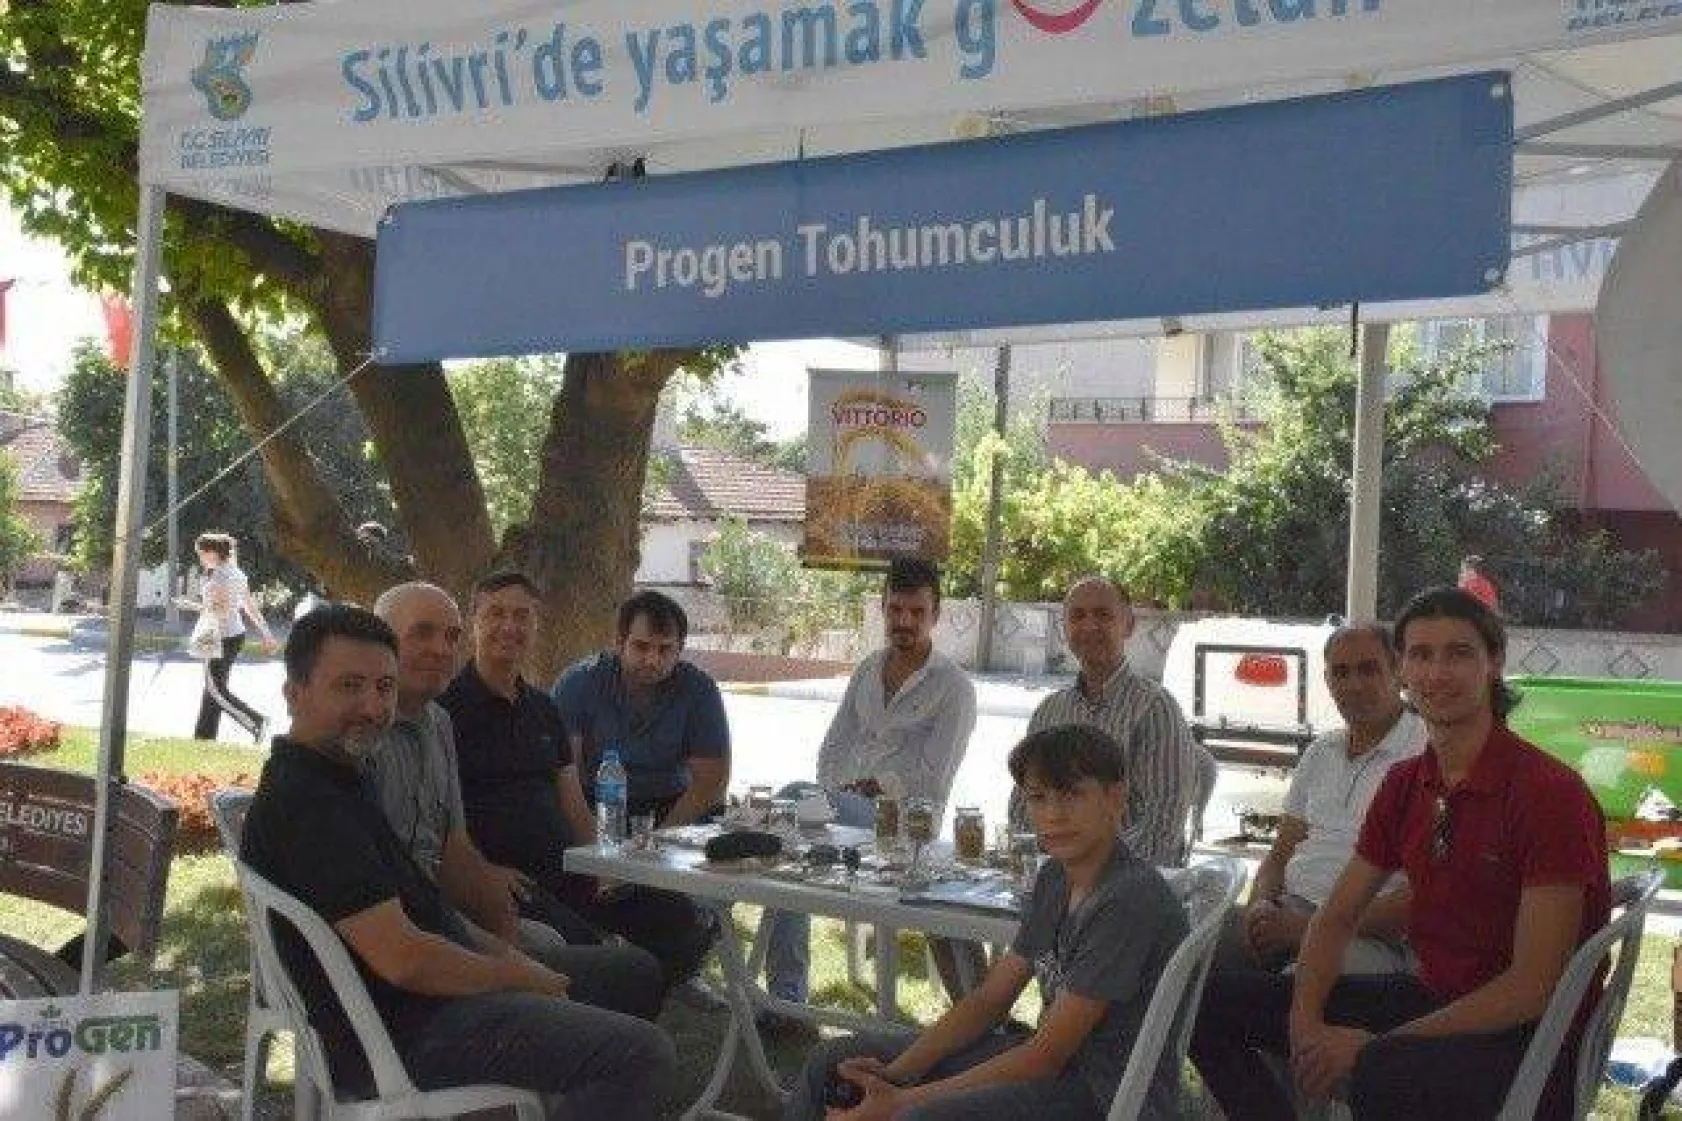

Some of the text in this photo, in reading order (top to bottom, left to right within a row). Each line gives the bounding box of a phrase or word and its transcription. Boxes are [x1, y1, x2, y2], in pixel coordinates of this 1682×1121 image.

[341, 22, 604, 122] Silivri'de
[625, 0, 928, 113] yaşamak
[624, 193, 1117, 298] Progen Tohumculuk
